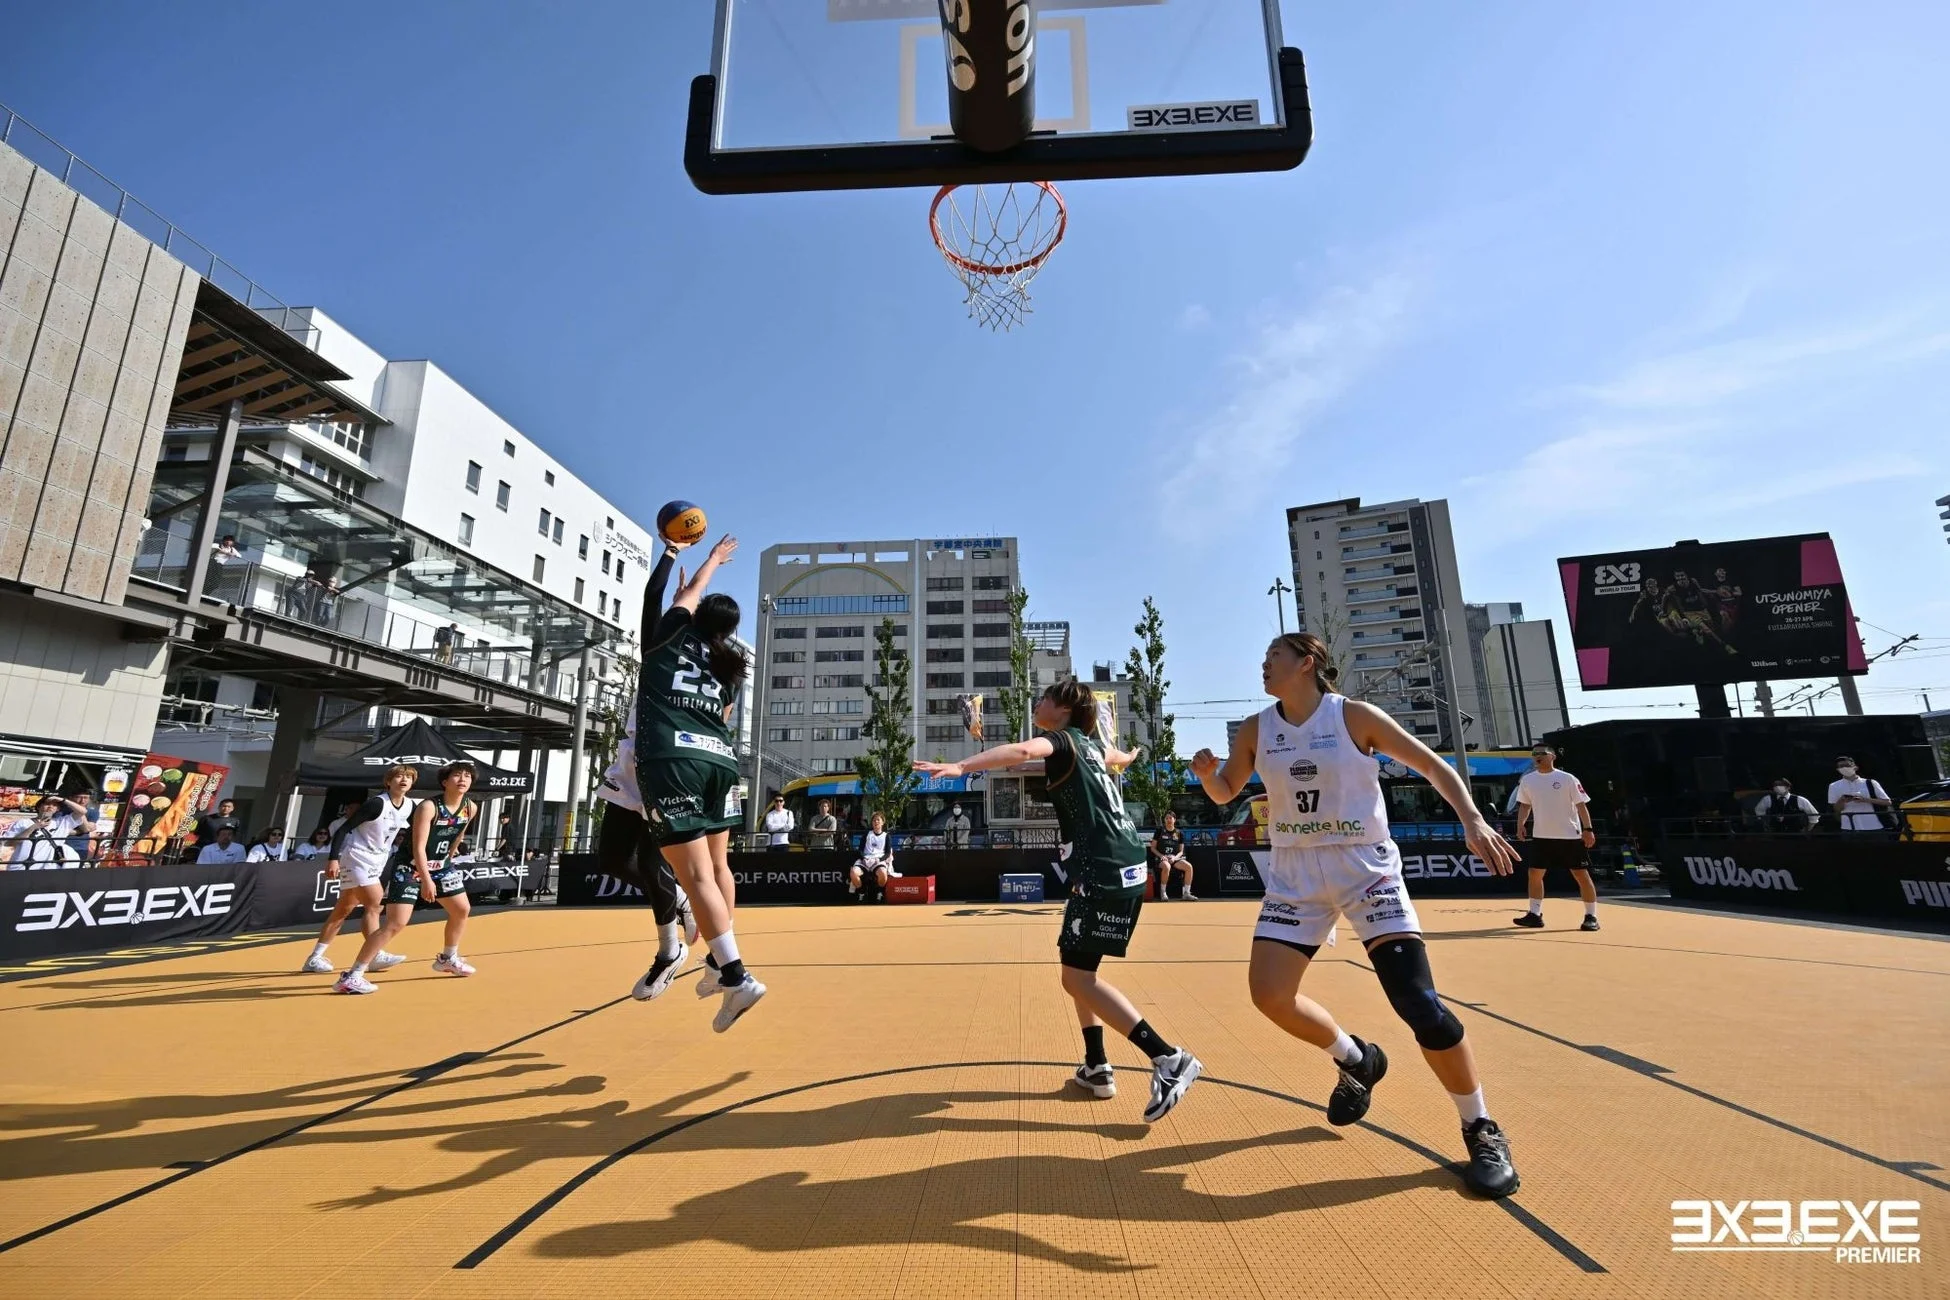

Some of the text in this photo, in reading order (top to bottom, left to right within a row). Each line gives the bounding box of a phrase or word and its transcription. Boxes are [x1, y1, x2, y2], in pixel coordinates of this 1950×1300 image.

[1755, 588, 1833, 604] UTSUNOMIYA
[1772, 601, 1825, 615] OPENER
[1295, 789, 1320, 813] 37
[1276, 821, 1332, 834] sonnette
[435, 840, 450, 854] 19
[733, 870, 843, 884] OLF PARTNER
[1684, 856, 1799, 891] Wilson
[15, 882, 235, 932] 3X3.EXE
[1100, 924, 1117, 932] GOLF
